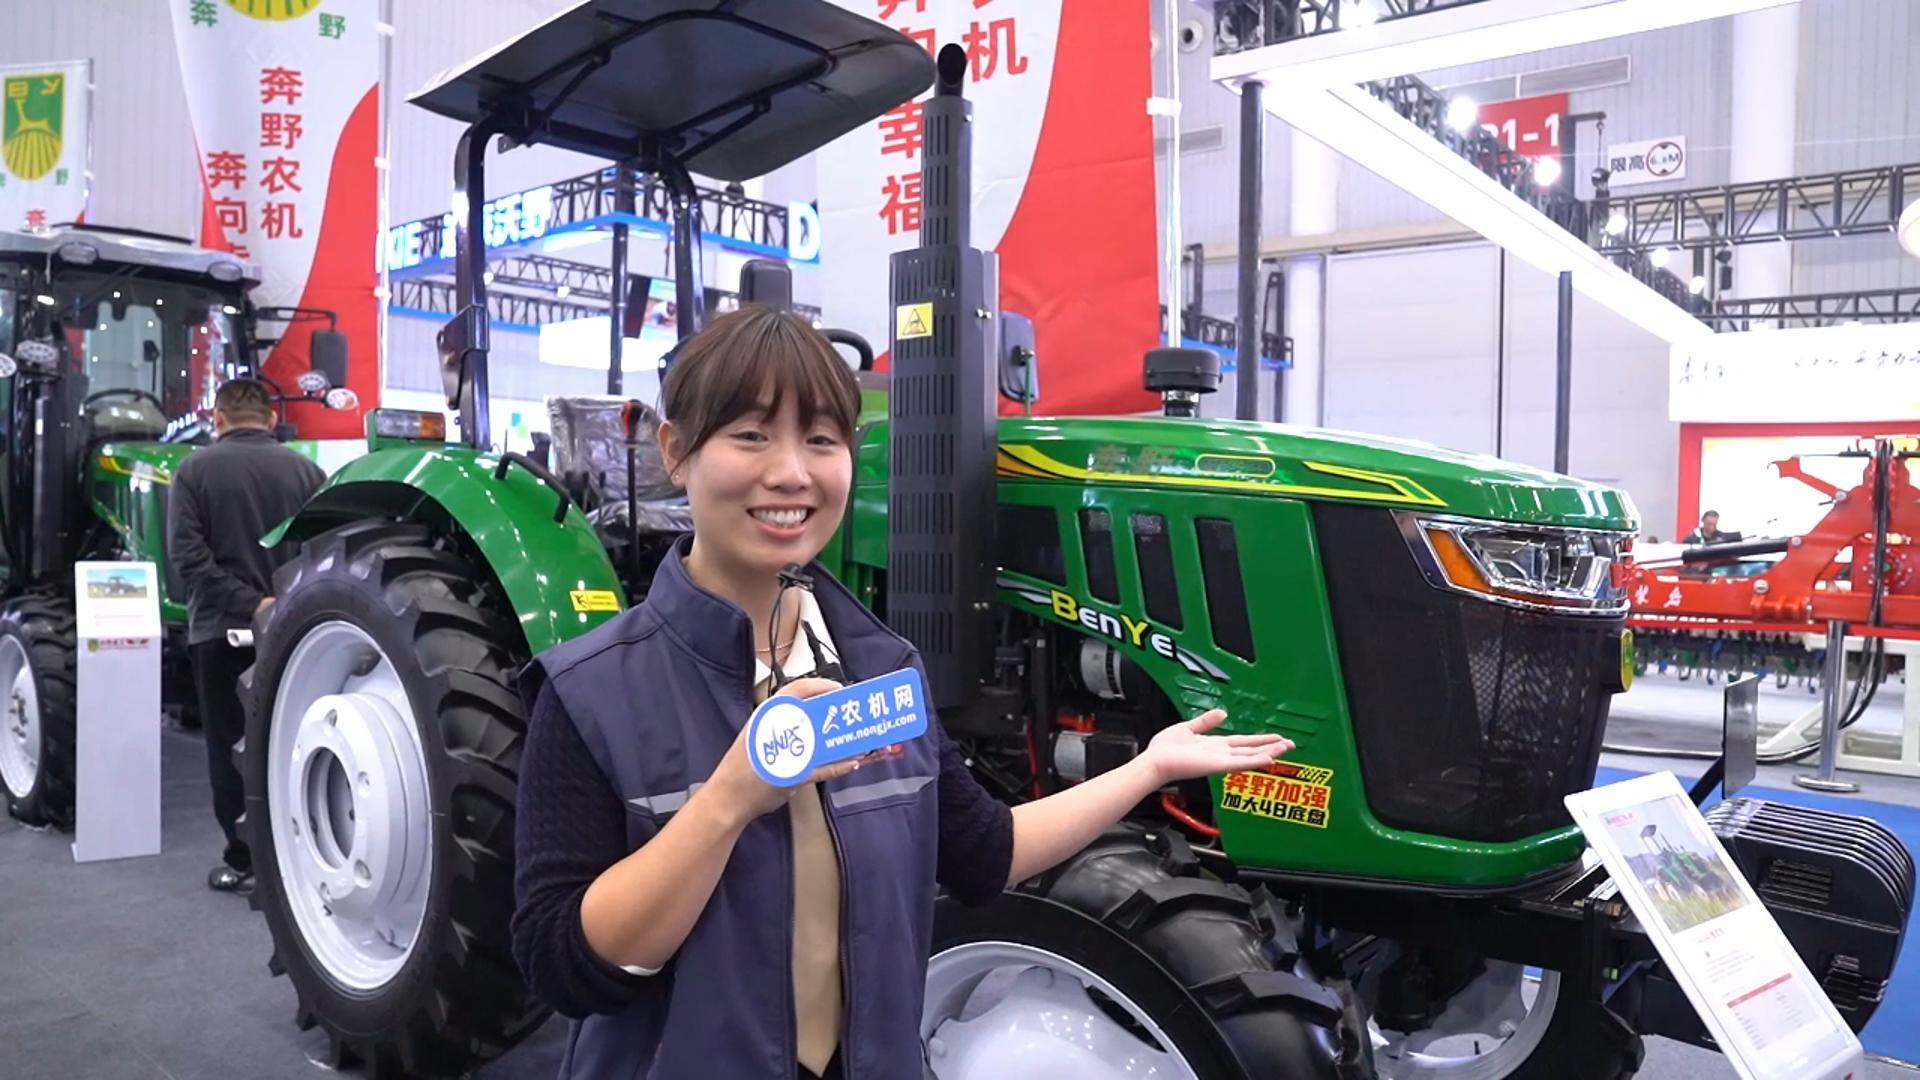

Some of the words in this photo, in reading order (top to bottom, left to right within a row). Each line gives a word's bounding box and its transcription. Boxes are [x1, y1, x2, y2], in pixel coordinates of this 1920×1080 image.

[319, 13, 345, 39] 野
[260, 67, 303, 239] 奔野农机
[841, 683, 914, 726] 农机网
[824, 713, 918, 749] www.nongjx.com
[1225, 771, 1328, 809] 奔野加强
